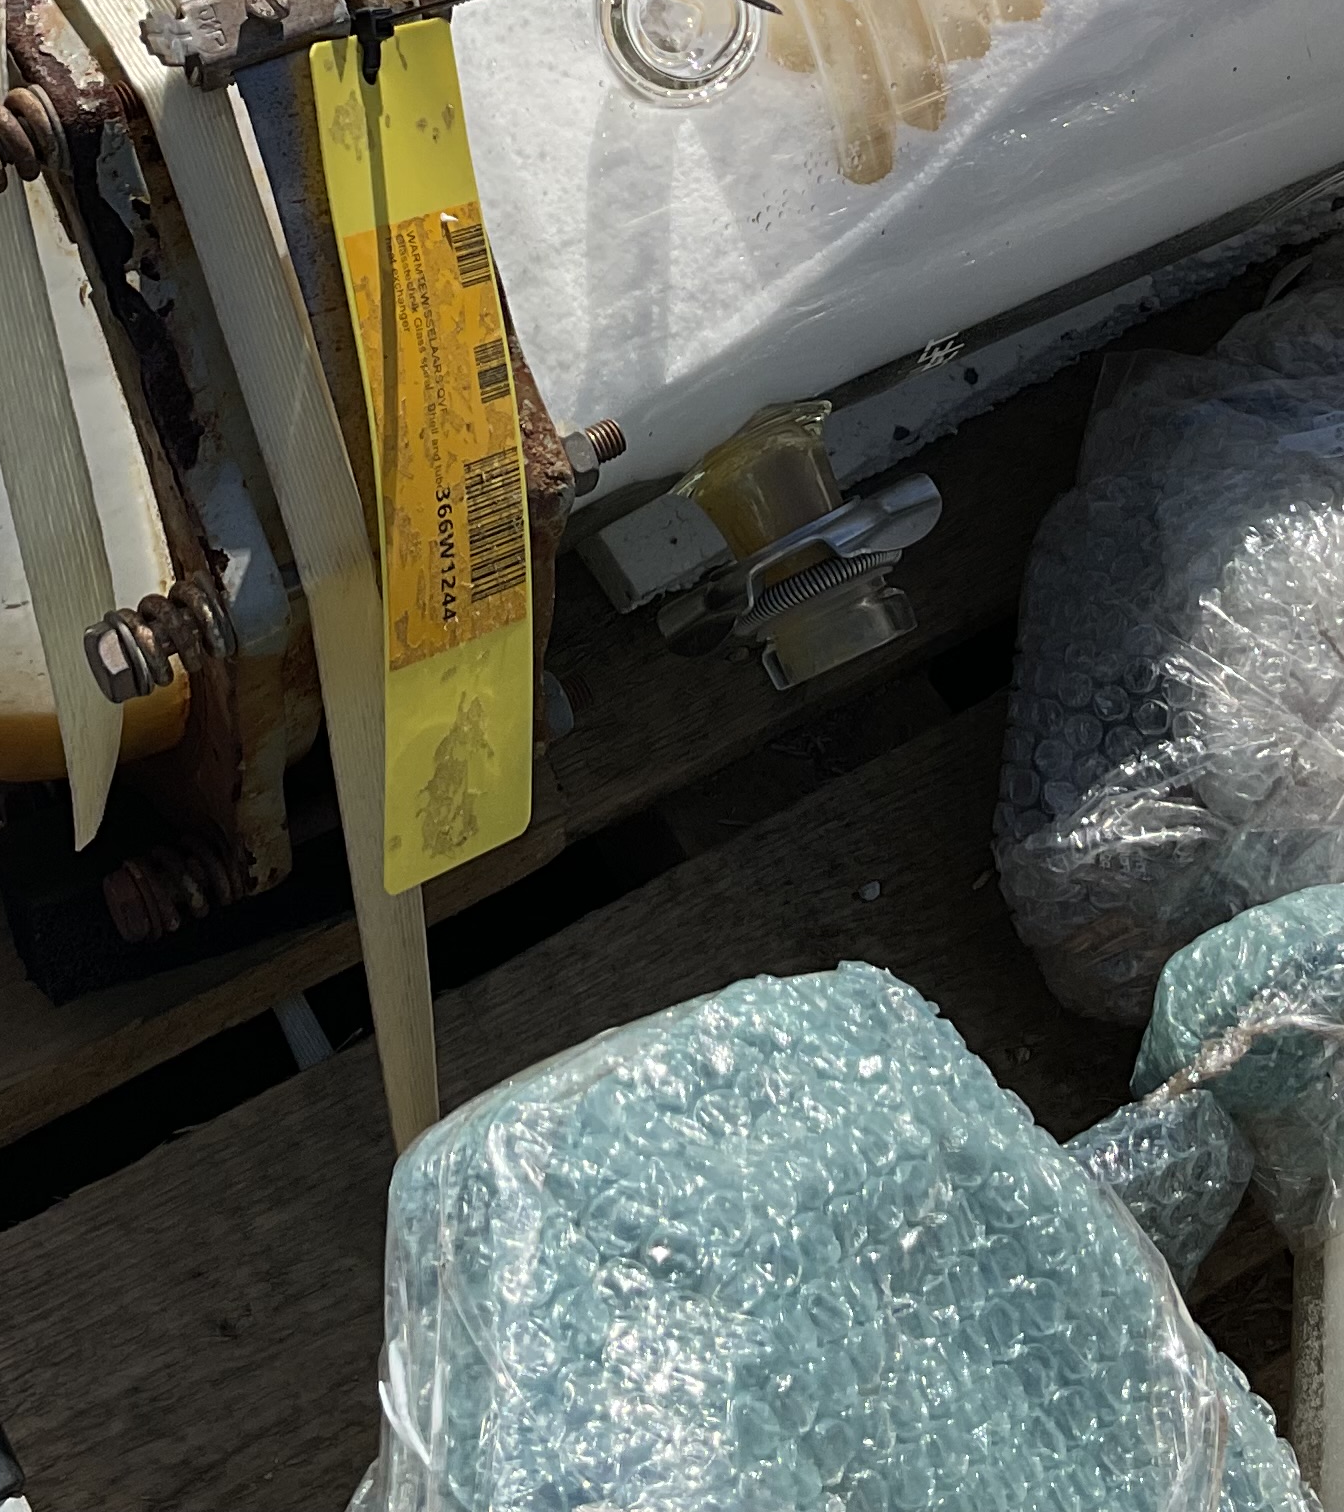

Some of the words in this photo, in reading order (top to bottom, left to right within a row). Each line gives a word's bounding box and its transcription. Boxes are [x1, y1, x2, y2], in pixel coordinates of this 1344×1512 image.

[392, 267, 411, 333] exchanger
[412, 317, 427, 354] Glass
[429, 437, 442, 463] and
[435, 487, 458, 623] 366W1244
